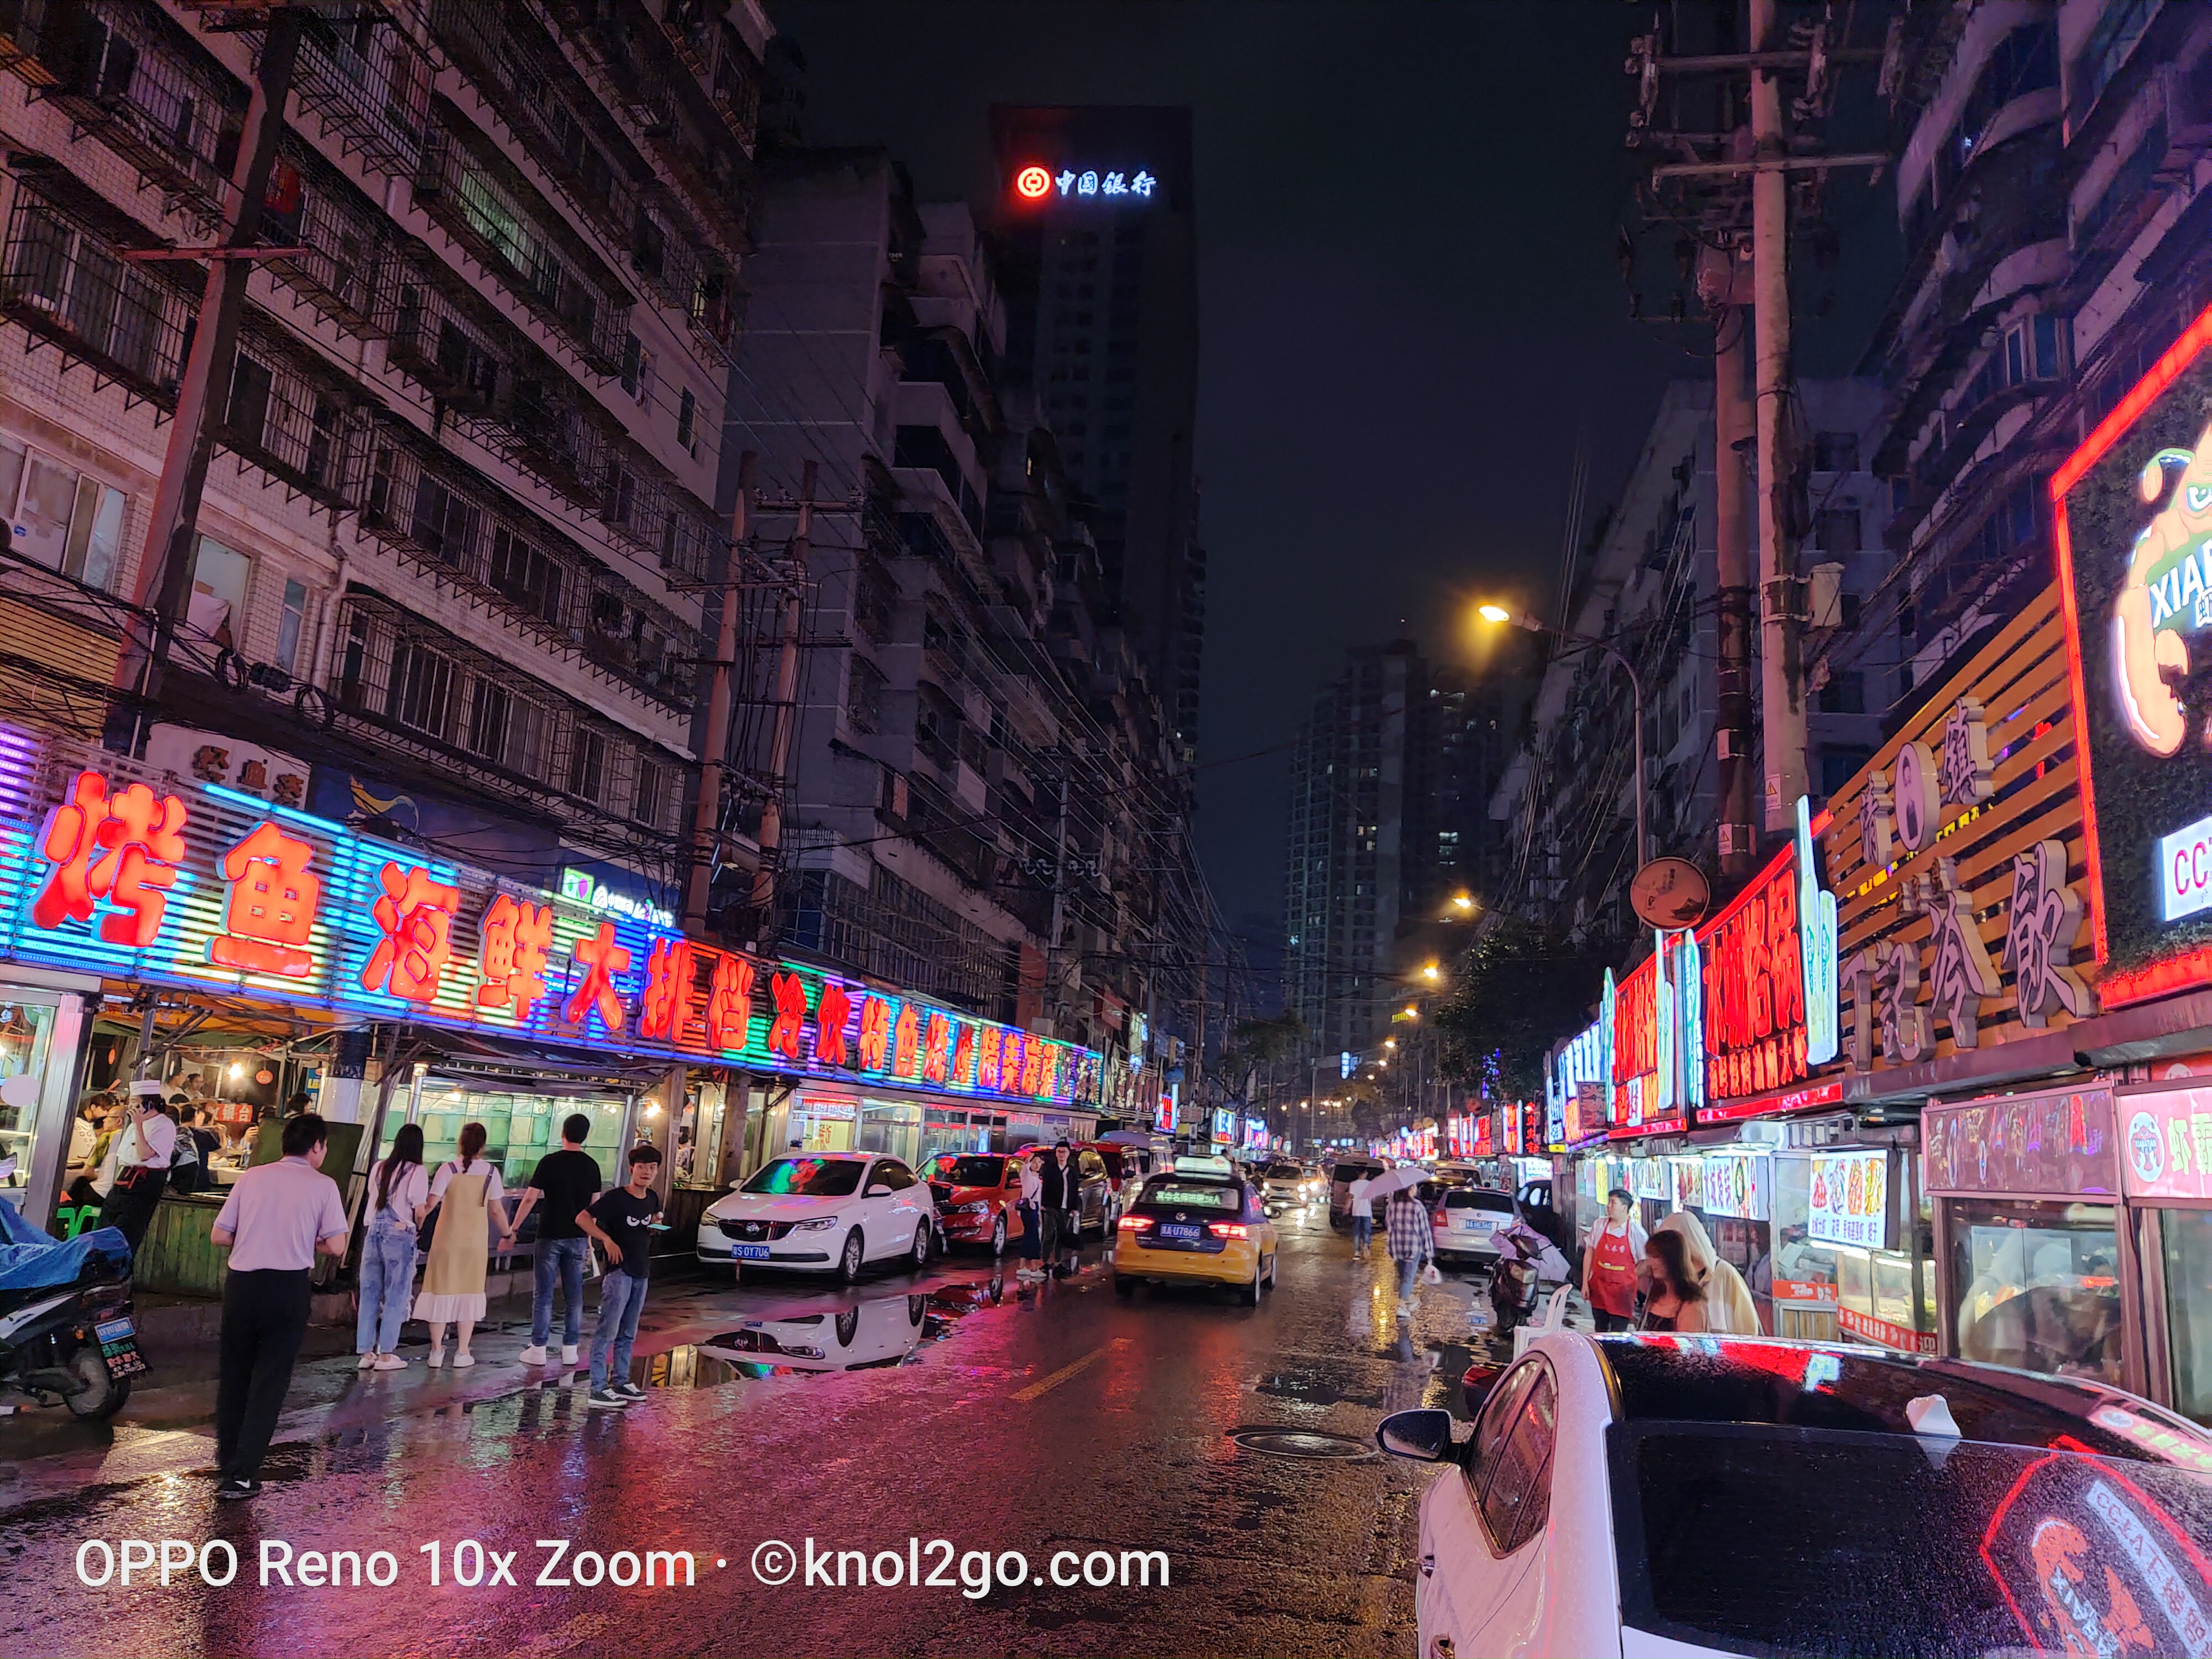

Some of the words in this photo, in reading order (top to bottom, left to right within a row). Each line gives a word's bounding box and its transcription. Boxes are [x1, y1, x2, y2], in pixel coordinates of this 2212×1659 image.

[1055, 169, 1156, 196] 中国银行
[2174, 837, 2212, 895] CC
